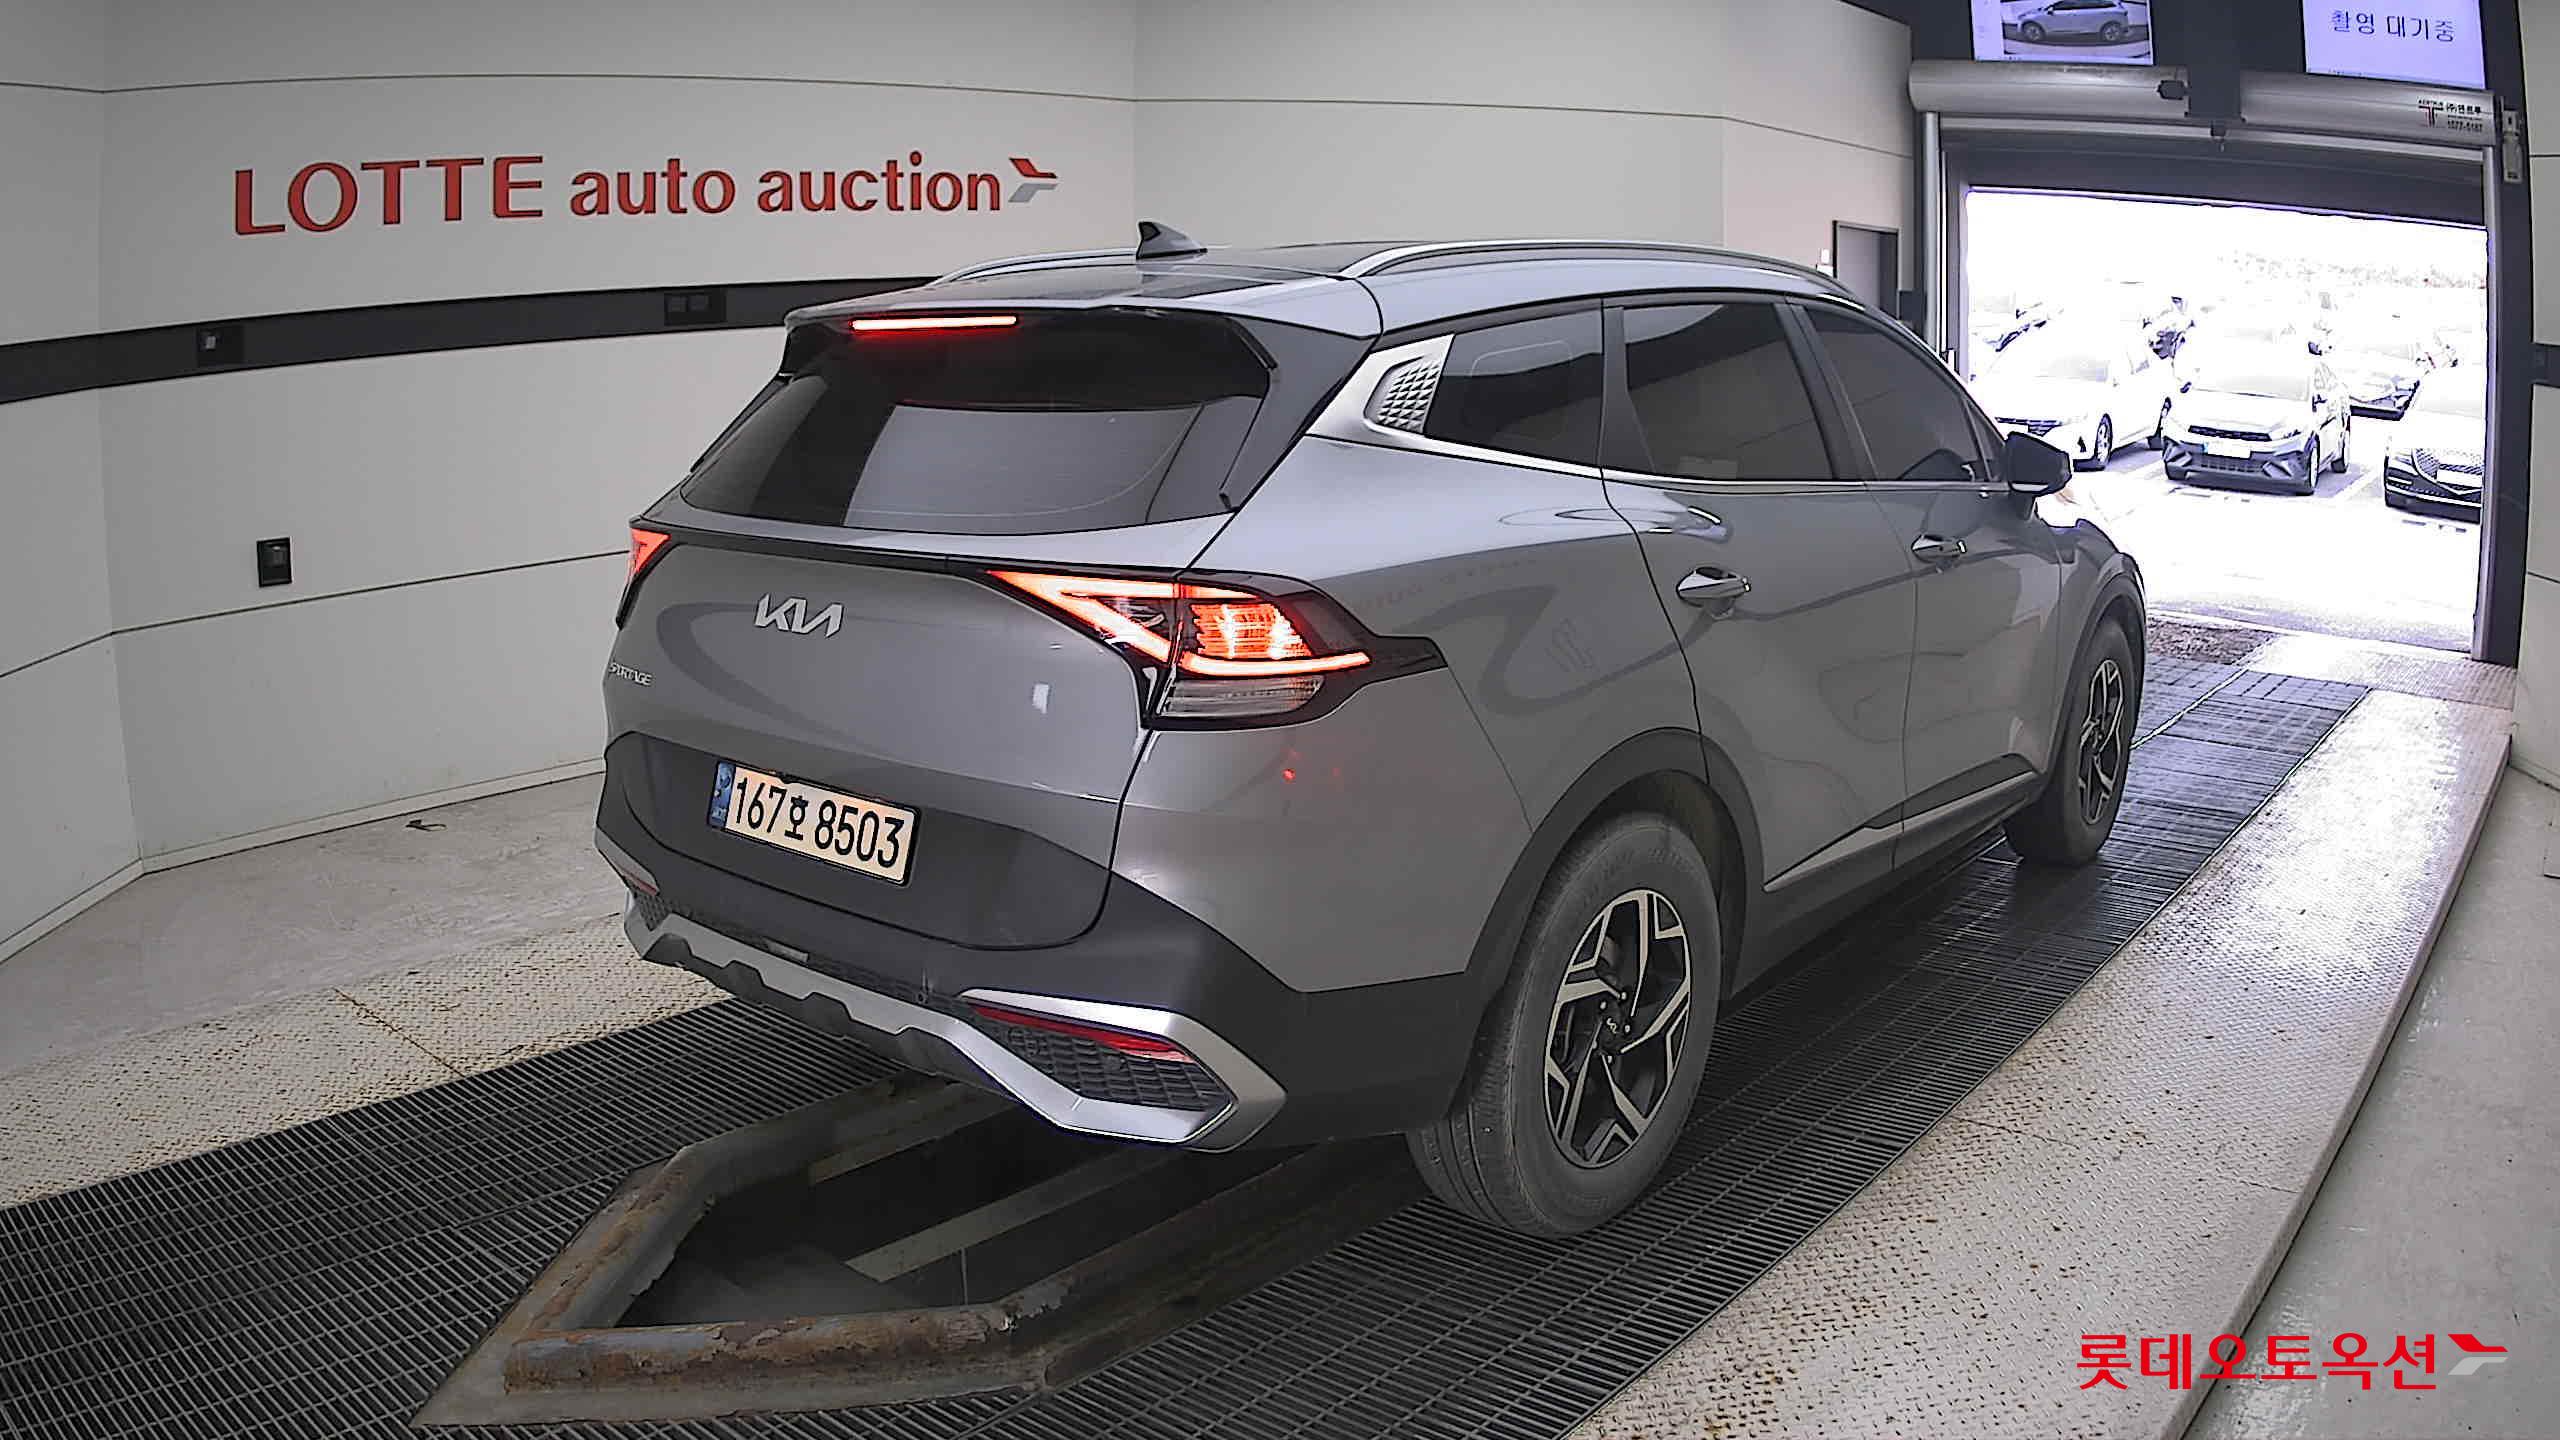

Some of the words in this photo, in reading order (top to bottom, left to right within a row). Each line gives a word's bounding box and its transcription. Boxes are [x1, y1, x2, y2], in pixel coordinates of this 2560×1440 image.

[2386, 15, 2454, 42] 대기중
[234, 156, 544, 236] LOTTE
[570, 158, 736, 217] auto
[757, 151, 1001, 214] auction
[754, 594, 843, 638] KIA
[734, 777, 809, 841] 167호
[814, 800, 905, 868] 8503
